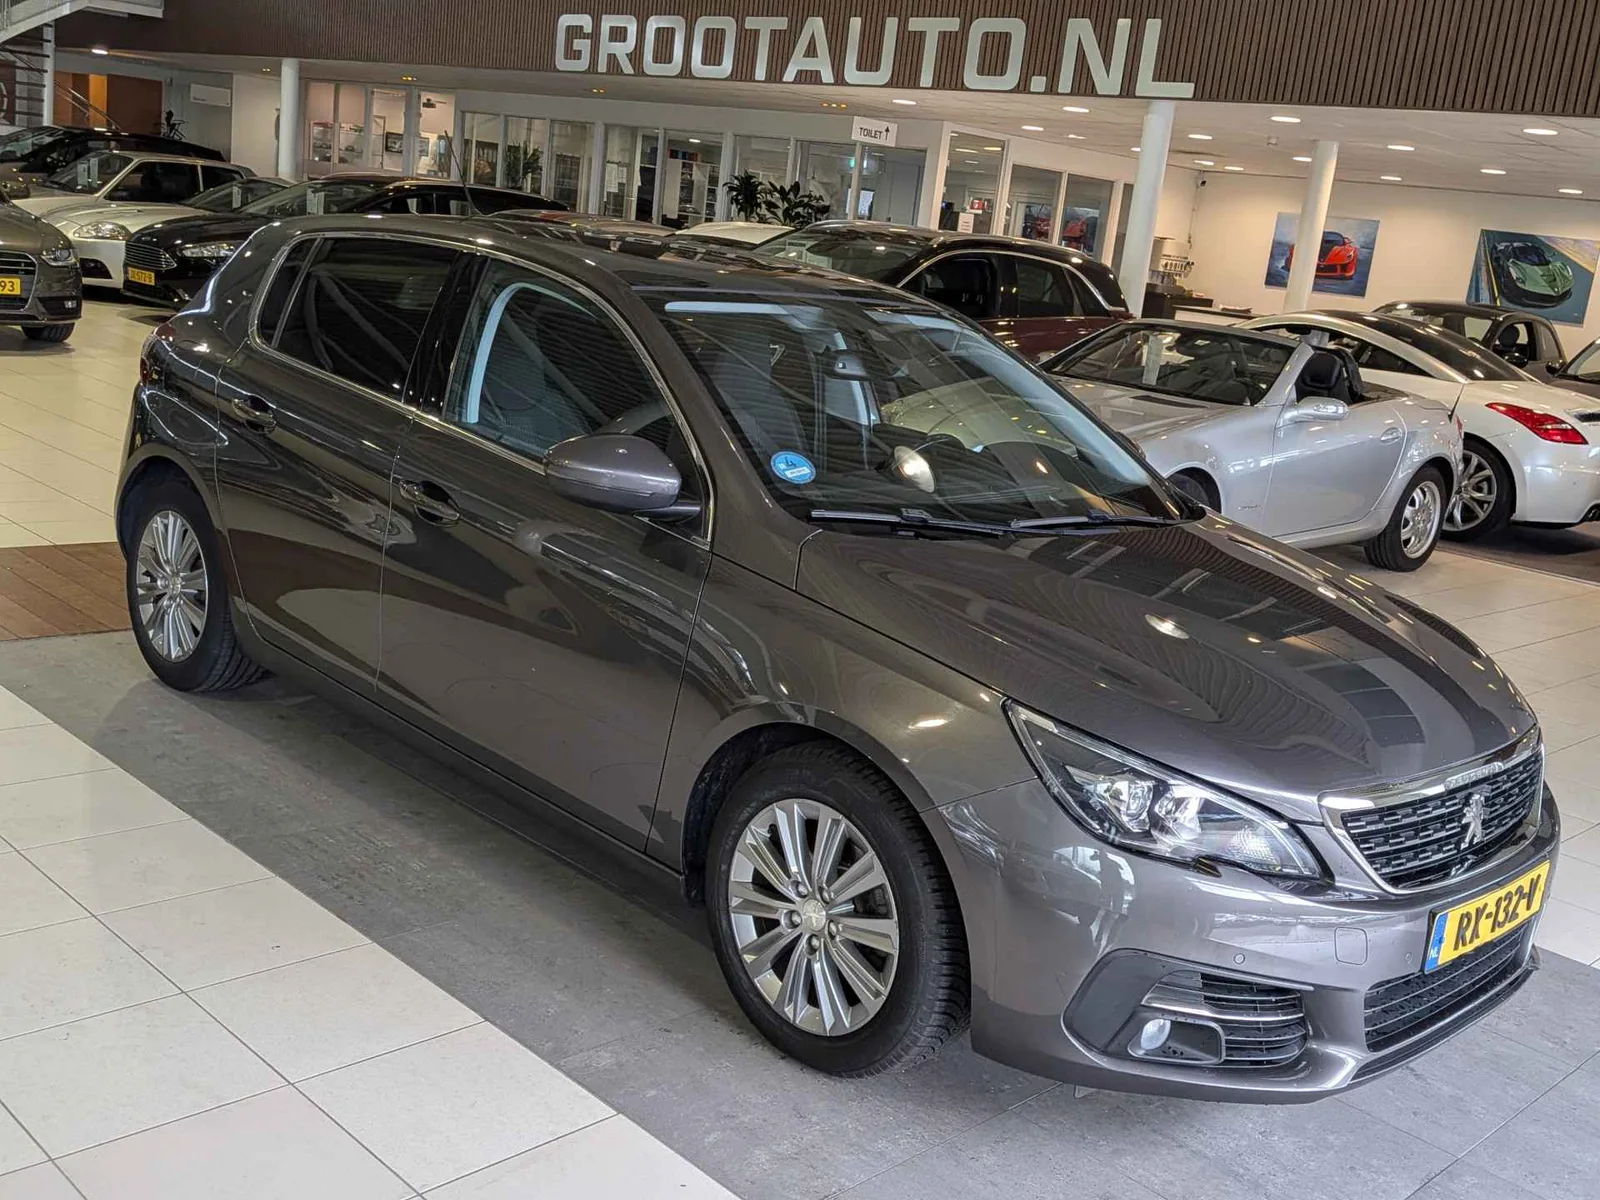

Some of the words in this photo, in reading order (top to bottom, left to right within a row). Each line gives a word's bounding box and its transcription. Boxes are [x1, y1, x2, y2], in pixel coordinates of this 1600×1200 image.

[555, 14, 1195, 98] GROOTAUTO.NL
[859, 127, 882, 140] TOILET
[1453, 874, 1542, 951] RX-132-V
[1429, 946, 1438, 961] NL
